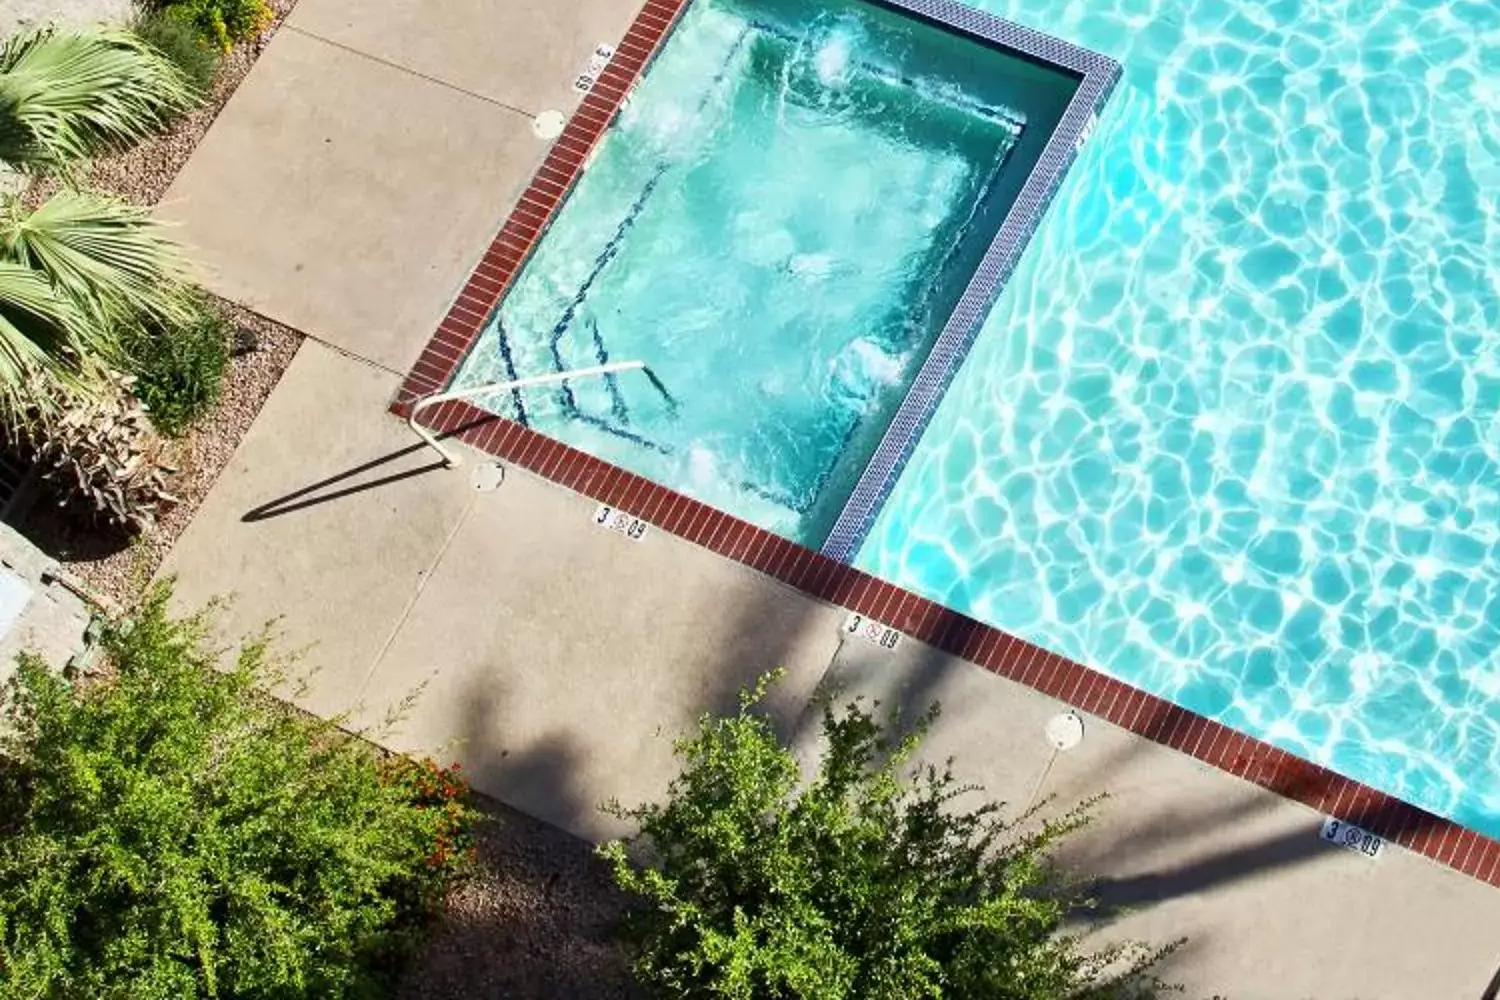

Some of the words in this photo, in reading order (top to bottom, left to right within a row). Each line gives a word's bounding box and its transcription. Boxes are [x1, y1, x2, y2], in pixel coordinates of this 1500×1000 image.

[597, 507, 611, 524] 3
[849, 615, 861, 633] 3
[1327, 820, 1340, 840] 3
